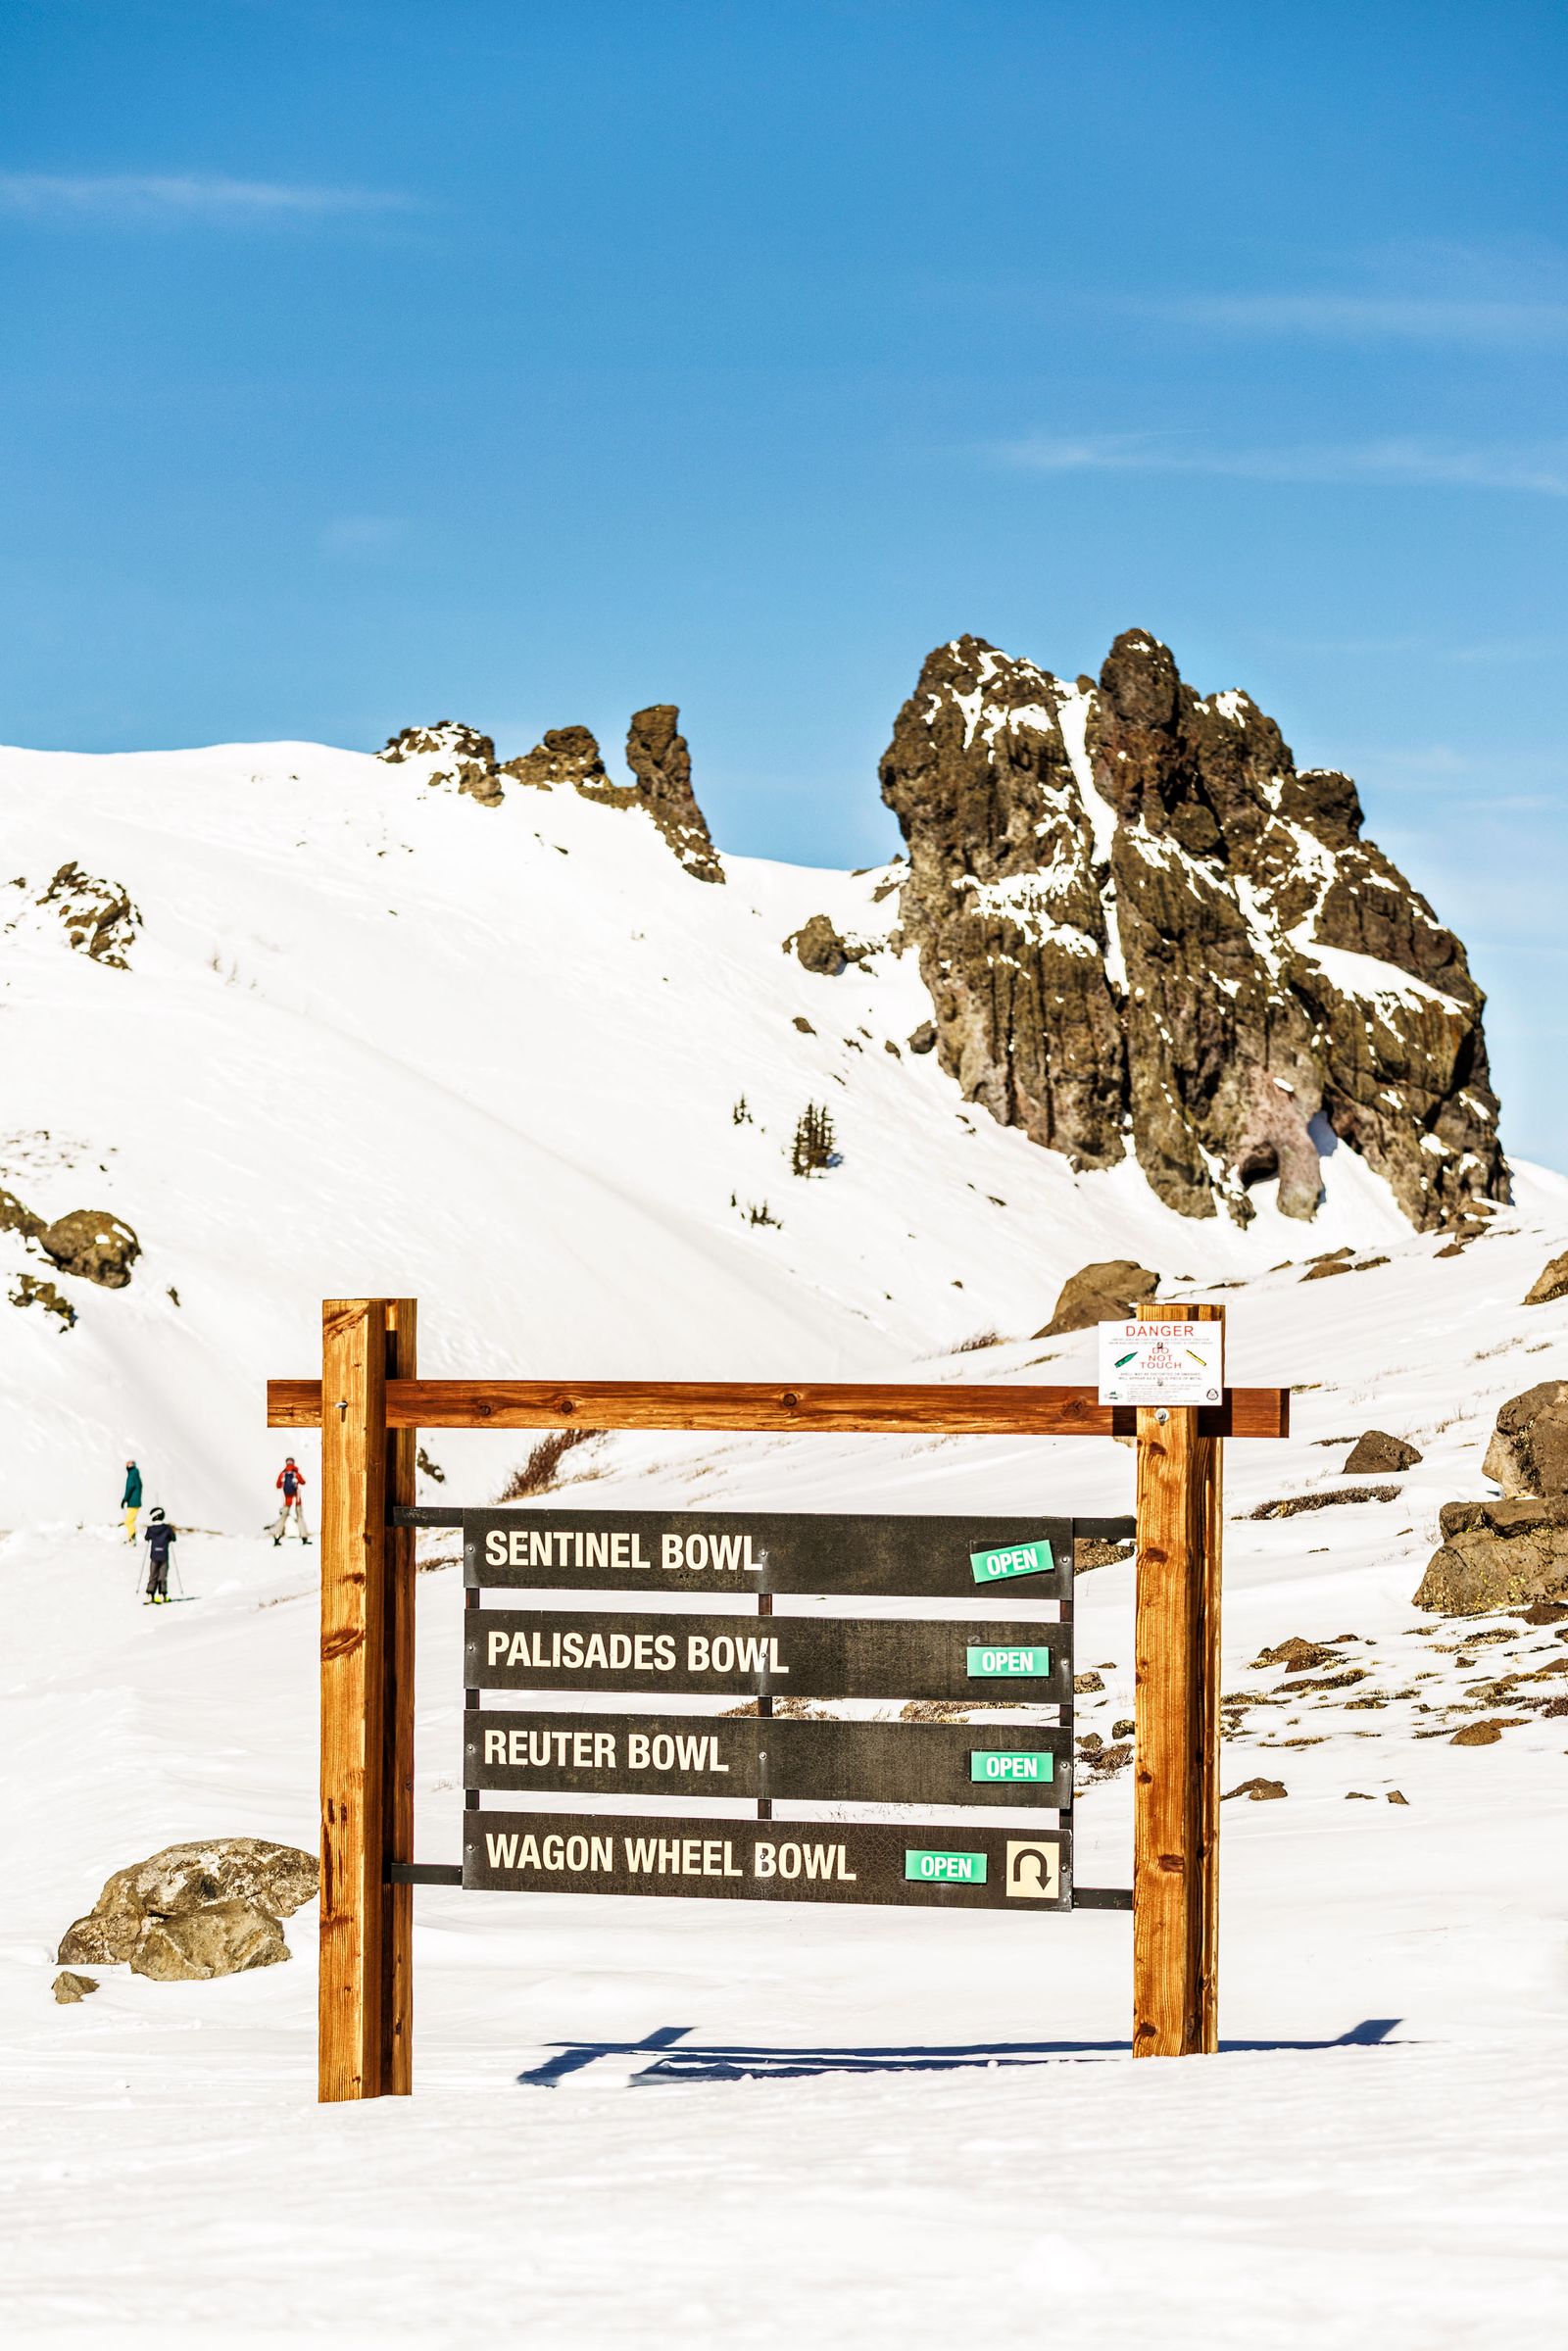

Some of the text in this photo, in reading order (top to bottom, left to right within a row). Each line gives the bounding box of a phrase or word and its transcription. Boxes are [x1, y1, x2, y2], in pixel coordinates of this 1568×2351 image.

[1125, 1325, 1195, 1337] DANGER
[485, 1530, 763, 1572] SENTINEL BOWL
[986, 1547, 1039, 1576] OPEN
[488, 1631, 790, 1674] PALISADES BOWL
[981, 1651, 1034, 1672] OPEN
[484, 1729, 730, 1772] REUTER BOWL
[986, 1756, 1038, 1778] OPEN
[485, 1833, 858, 1882] WAGON WHEEL BOWL
[920, 1855, 972, 1879] OPEN
